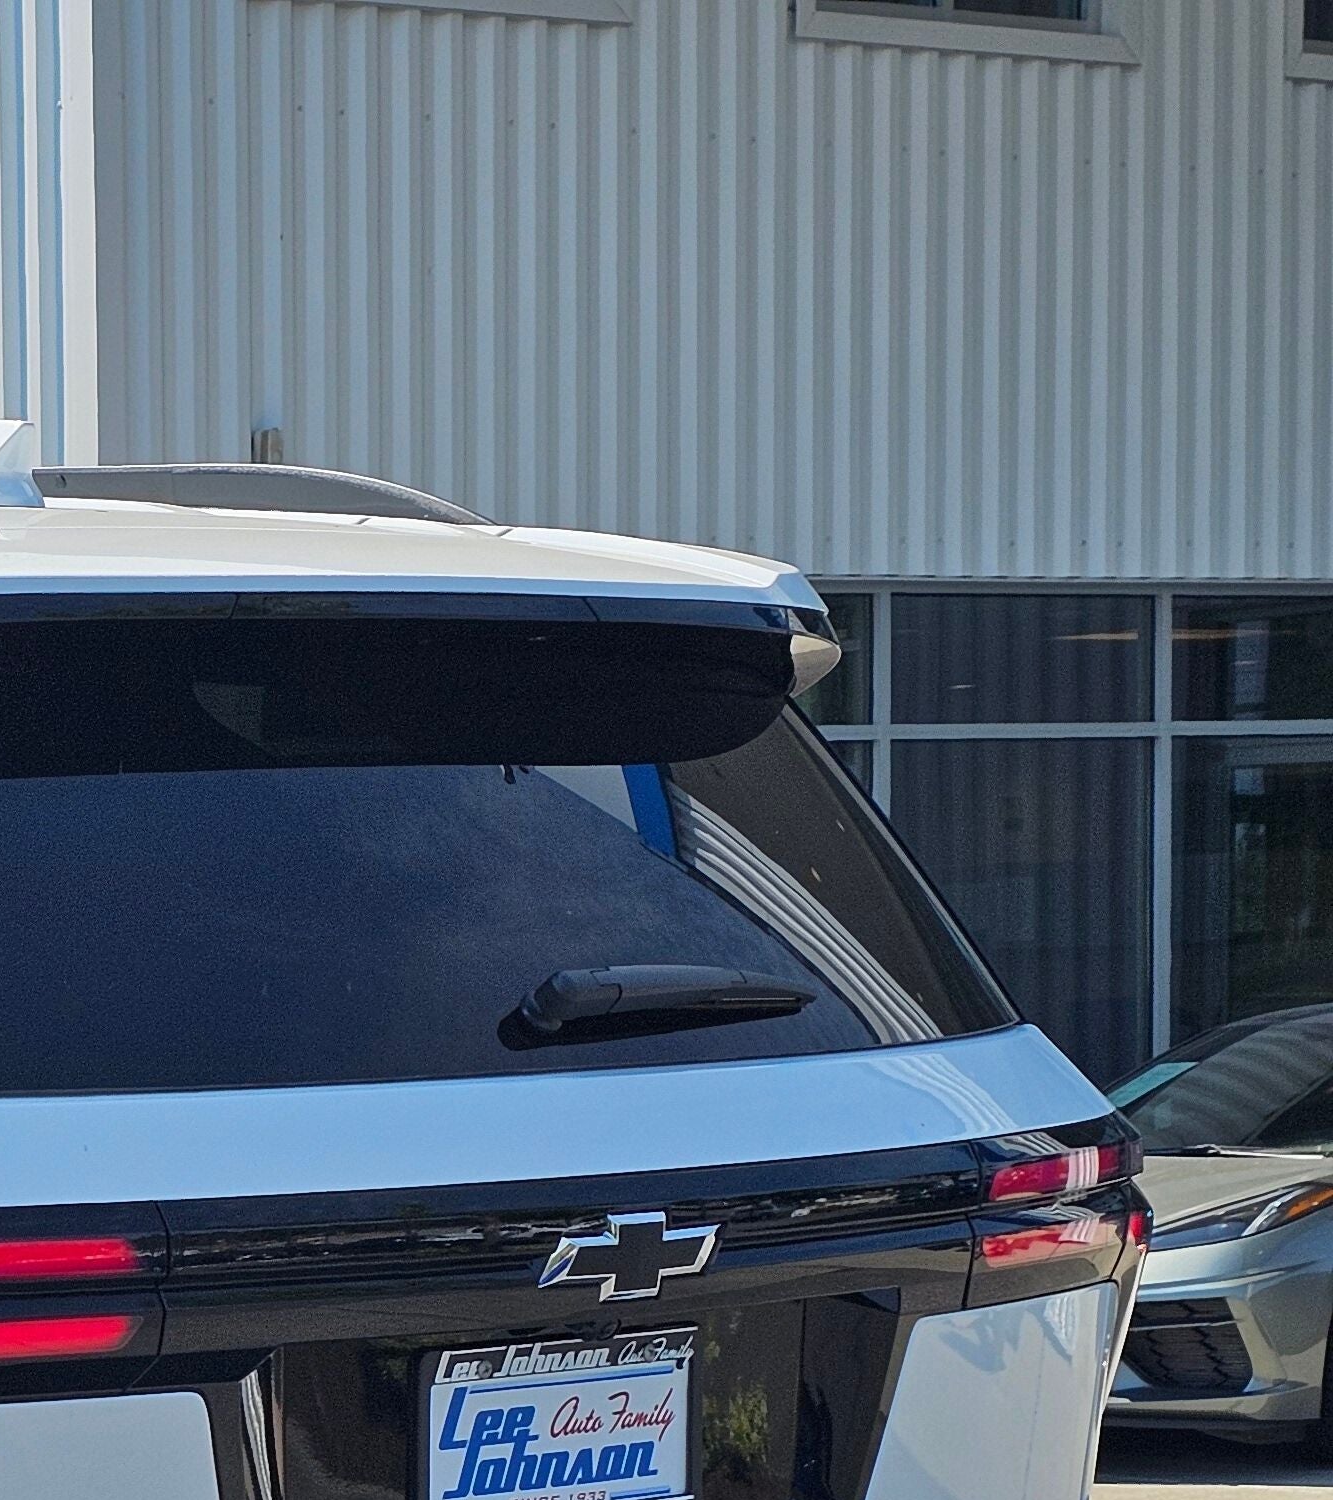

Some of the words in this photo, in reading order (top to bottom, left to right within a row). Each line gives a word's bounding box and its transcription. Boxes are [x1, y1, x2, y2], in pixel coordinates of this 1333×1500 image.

[493, 1342, 611, 1377] Johnson
[617, 1340, 646, 1365] Aut
[652, 1335, 695, 1368] Family
[438, 1386, 539, 1451] Lee
[549, 1395, 604, 1439] Auto
[607, 1387, 677, 1442] Family
[443, 1430, 659, 1500] Johnson
